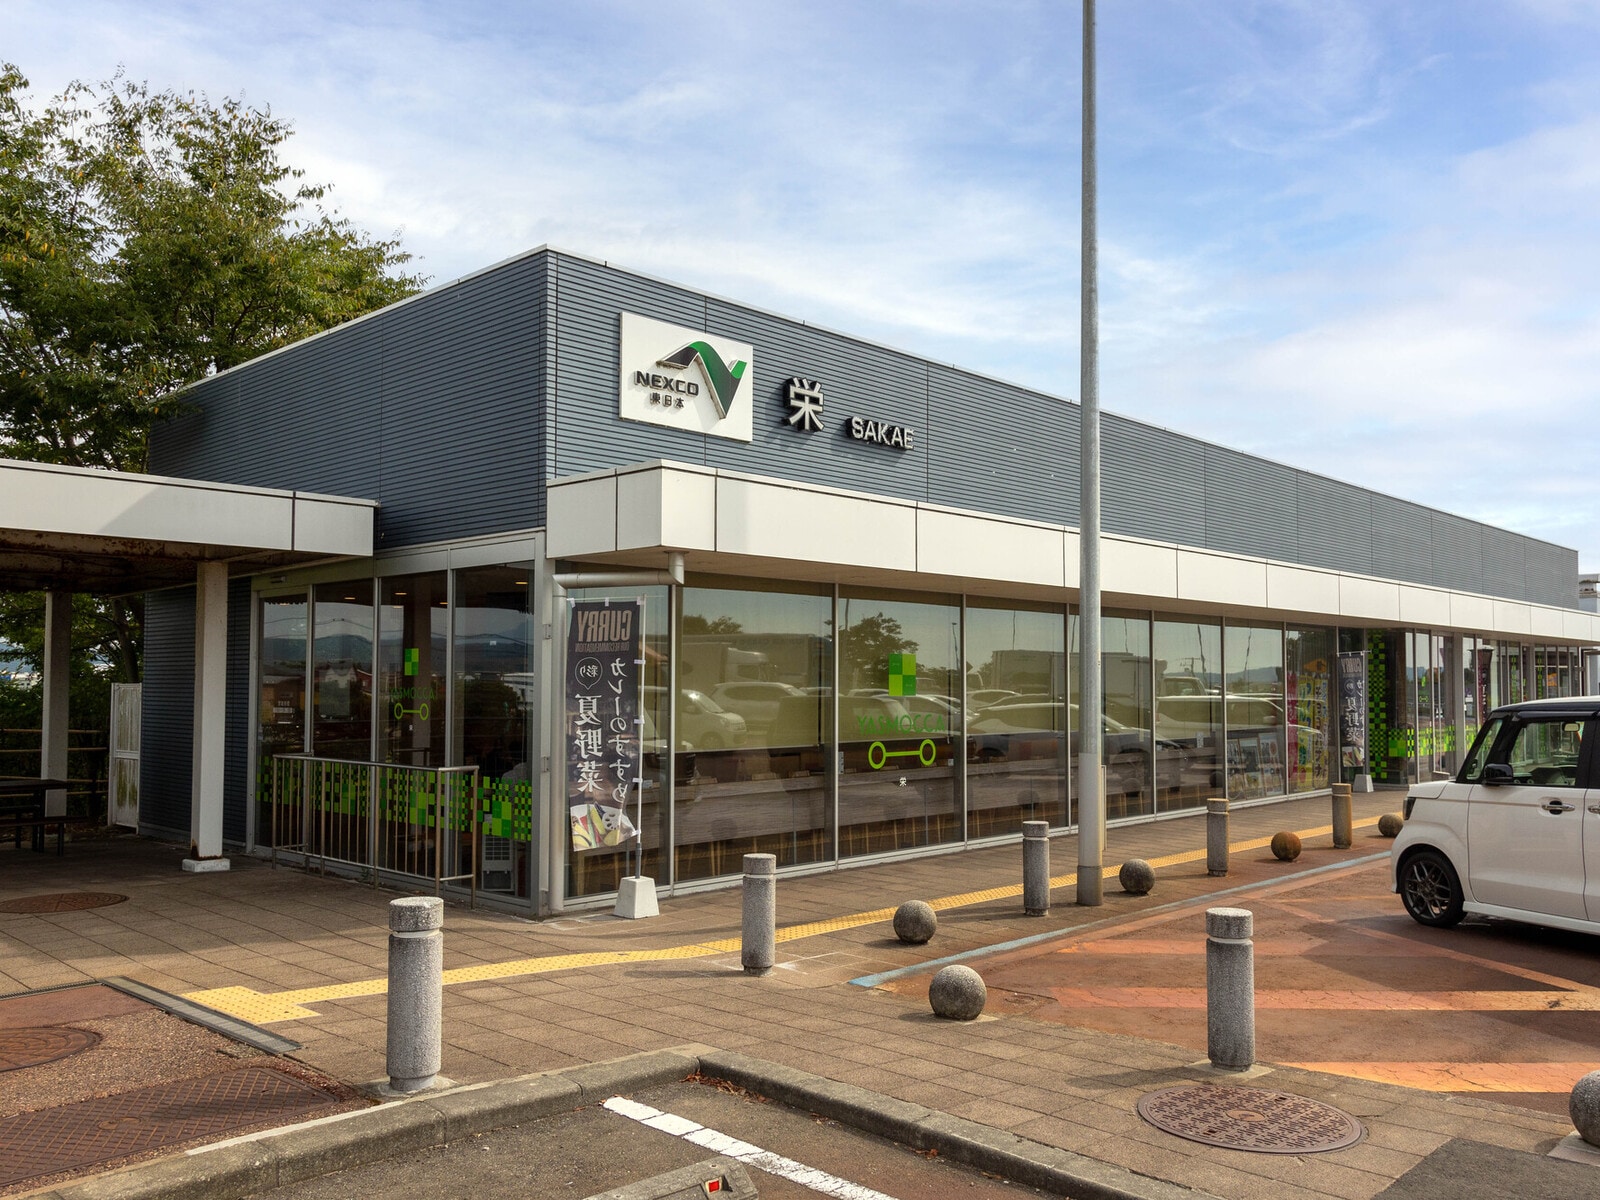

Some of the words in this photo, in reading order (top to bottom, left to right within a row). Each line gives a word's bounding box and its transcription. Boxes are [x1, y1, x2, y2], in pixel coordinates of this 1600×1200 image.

[634, 370, 699, 397] NEXCO
[650, 392, 686, 409] 東日本
[785, 377, 825, 432] 栄
[848, 416, 914, 449] SAKAE
[857, 713, 945, 735] YASMOCCA
